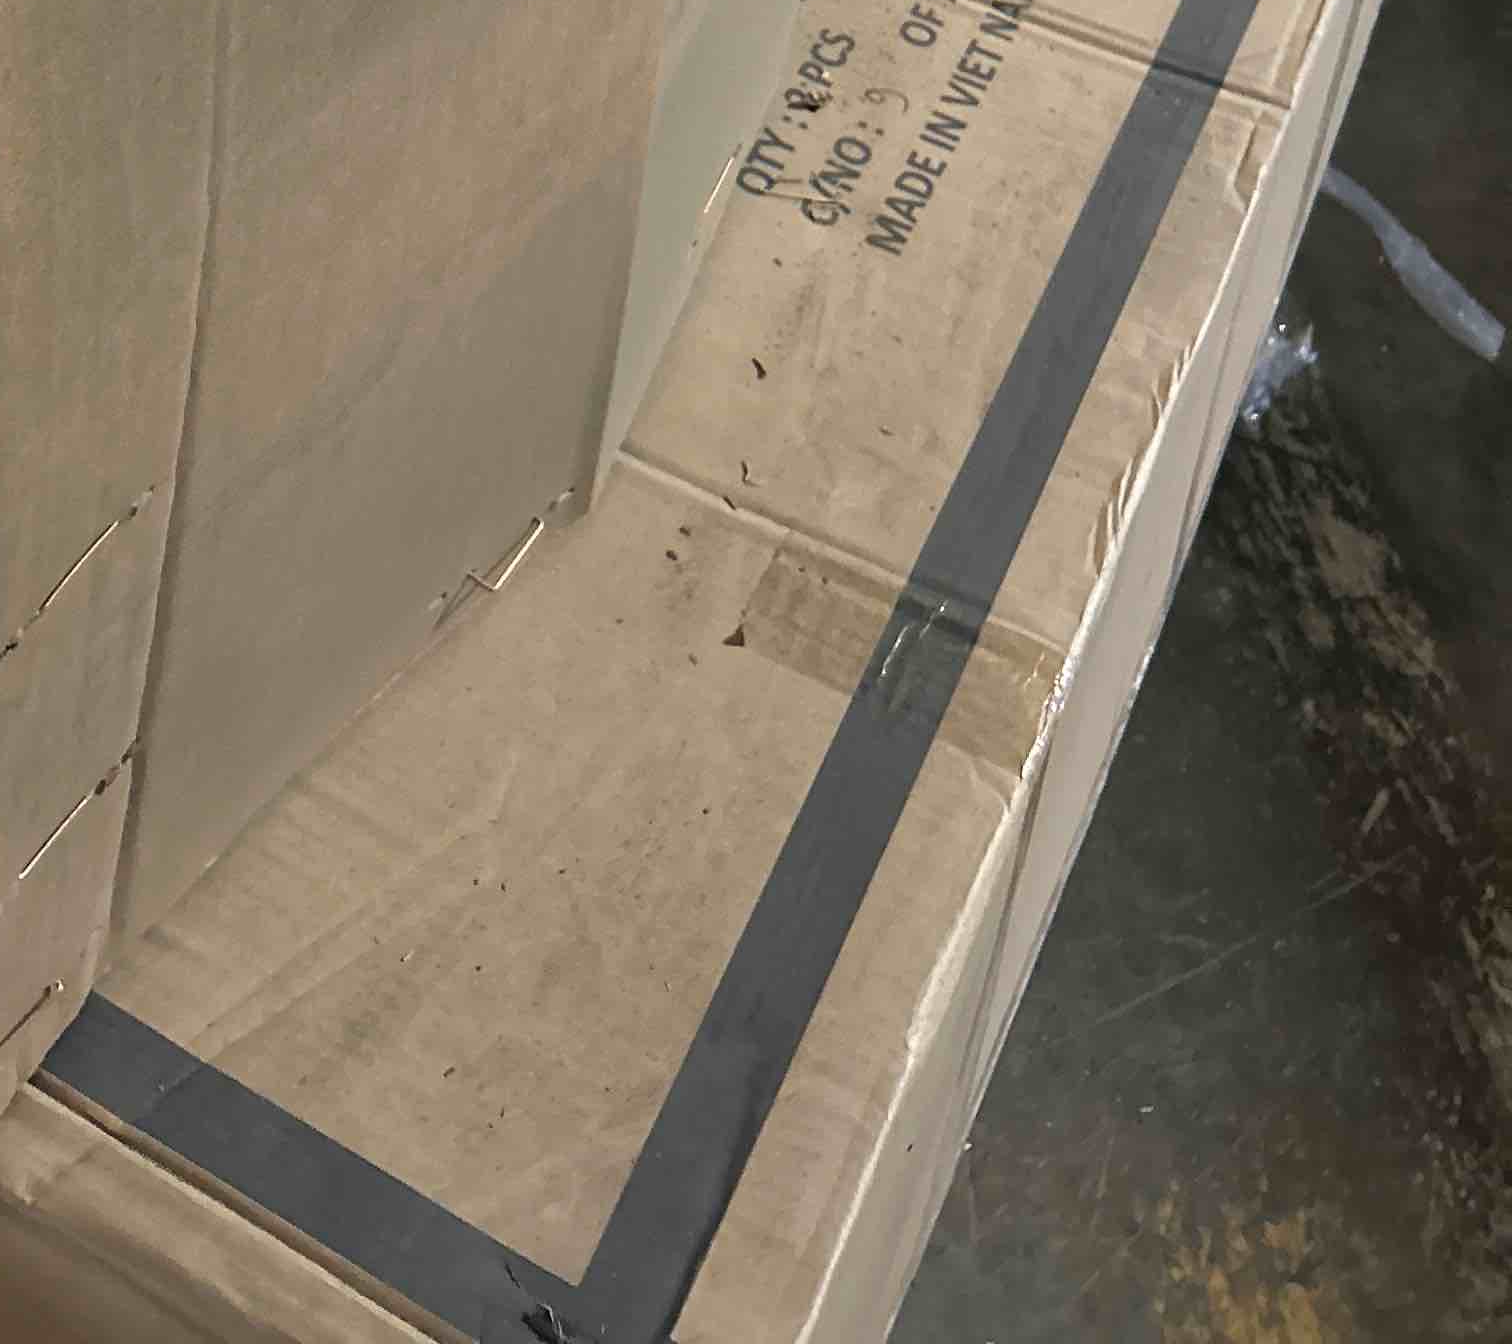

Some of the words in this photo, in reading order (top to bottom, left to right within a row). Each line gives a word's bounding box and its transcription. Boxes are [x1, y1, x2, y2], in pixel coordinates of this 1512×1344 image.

[898, 2, 945, 48] OF
[940, 39, 1004, 107] VIET
[736, 127, 795, 196] QTY
[919, 110, 968, 152] IN
[865, 150, 948, 256] MADE
